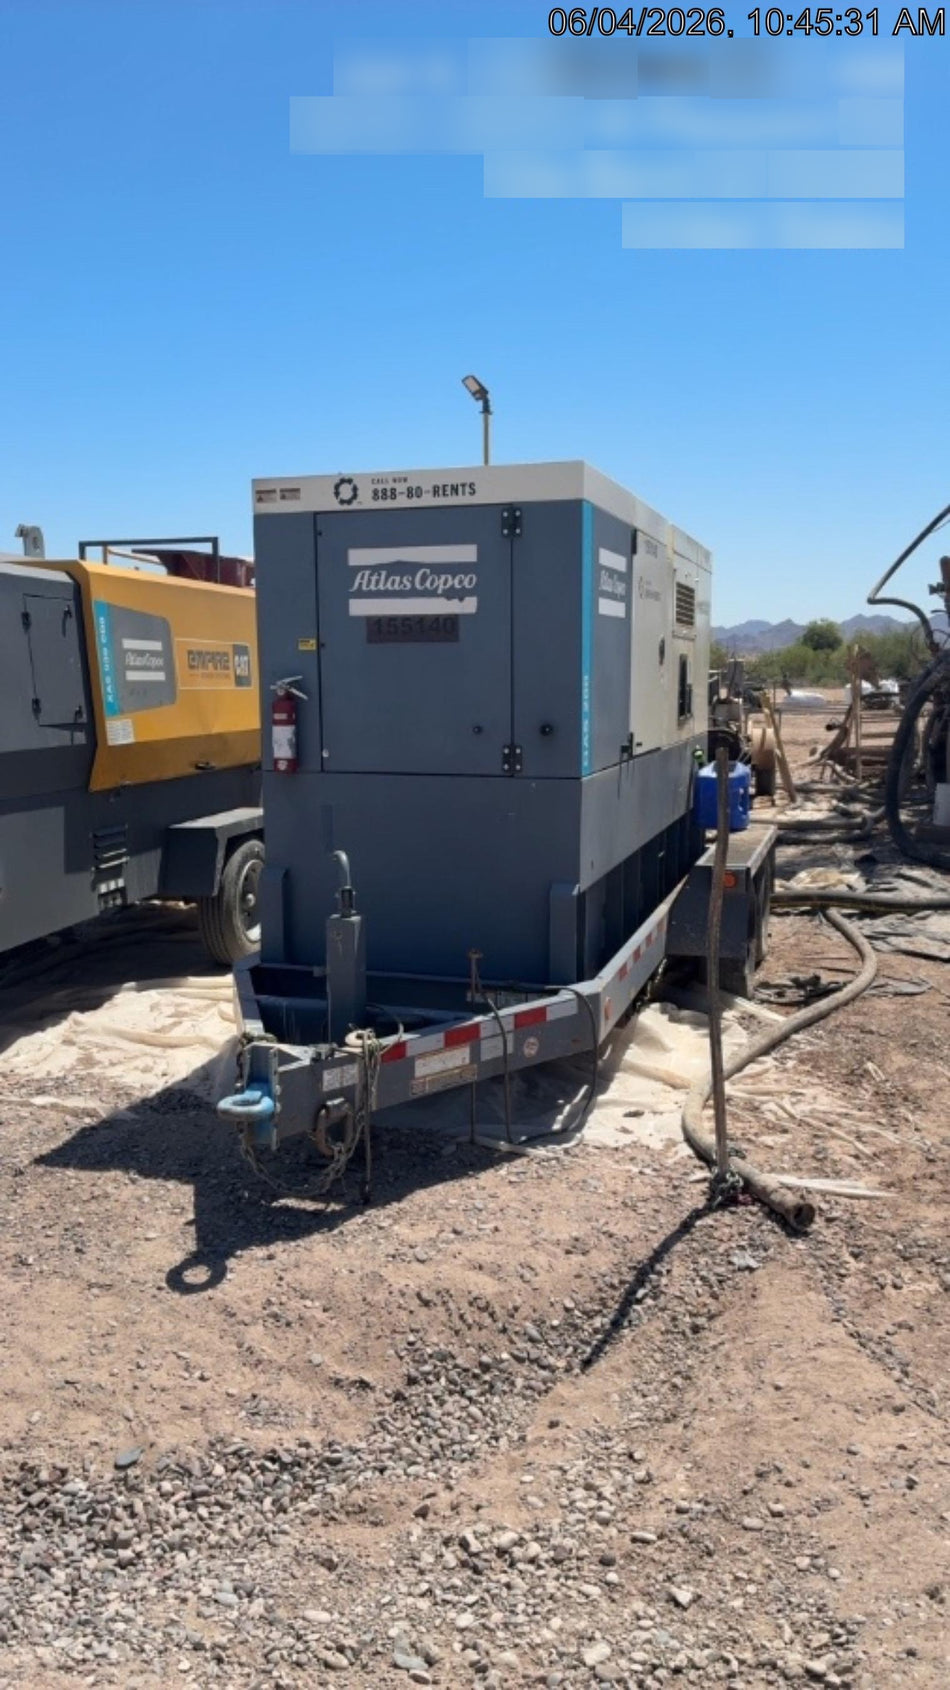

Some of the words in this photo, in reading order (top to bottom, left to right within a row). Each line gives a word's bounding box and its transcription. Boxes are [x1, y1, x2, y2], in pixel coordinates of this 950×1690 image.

[371, 482, 477, 501] 888-80-RENTS
[349, 569, 413, 592] Atlas
[414, 567, 478, 594] Copco
[374, 616, 457, 636] 155140
